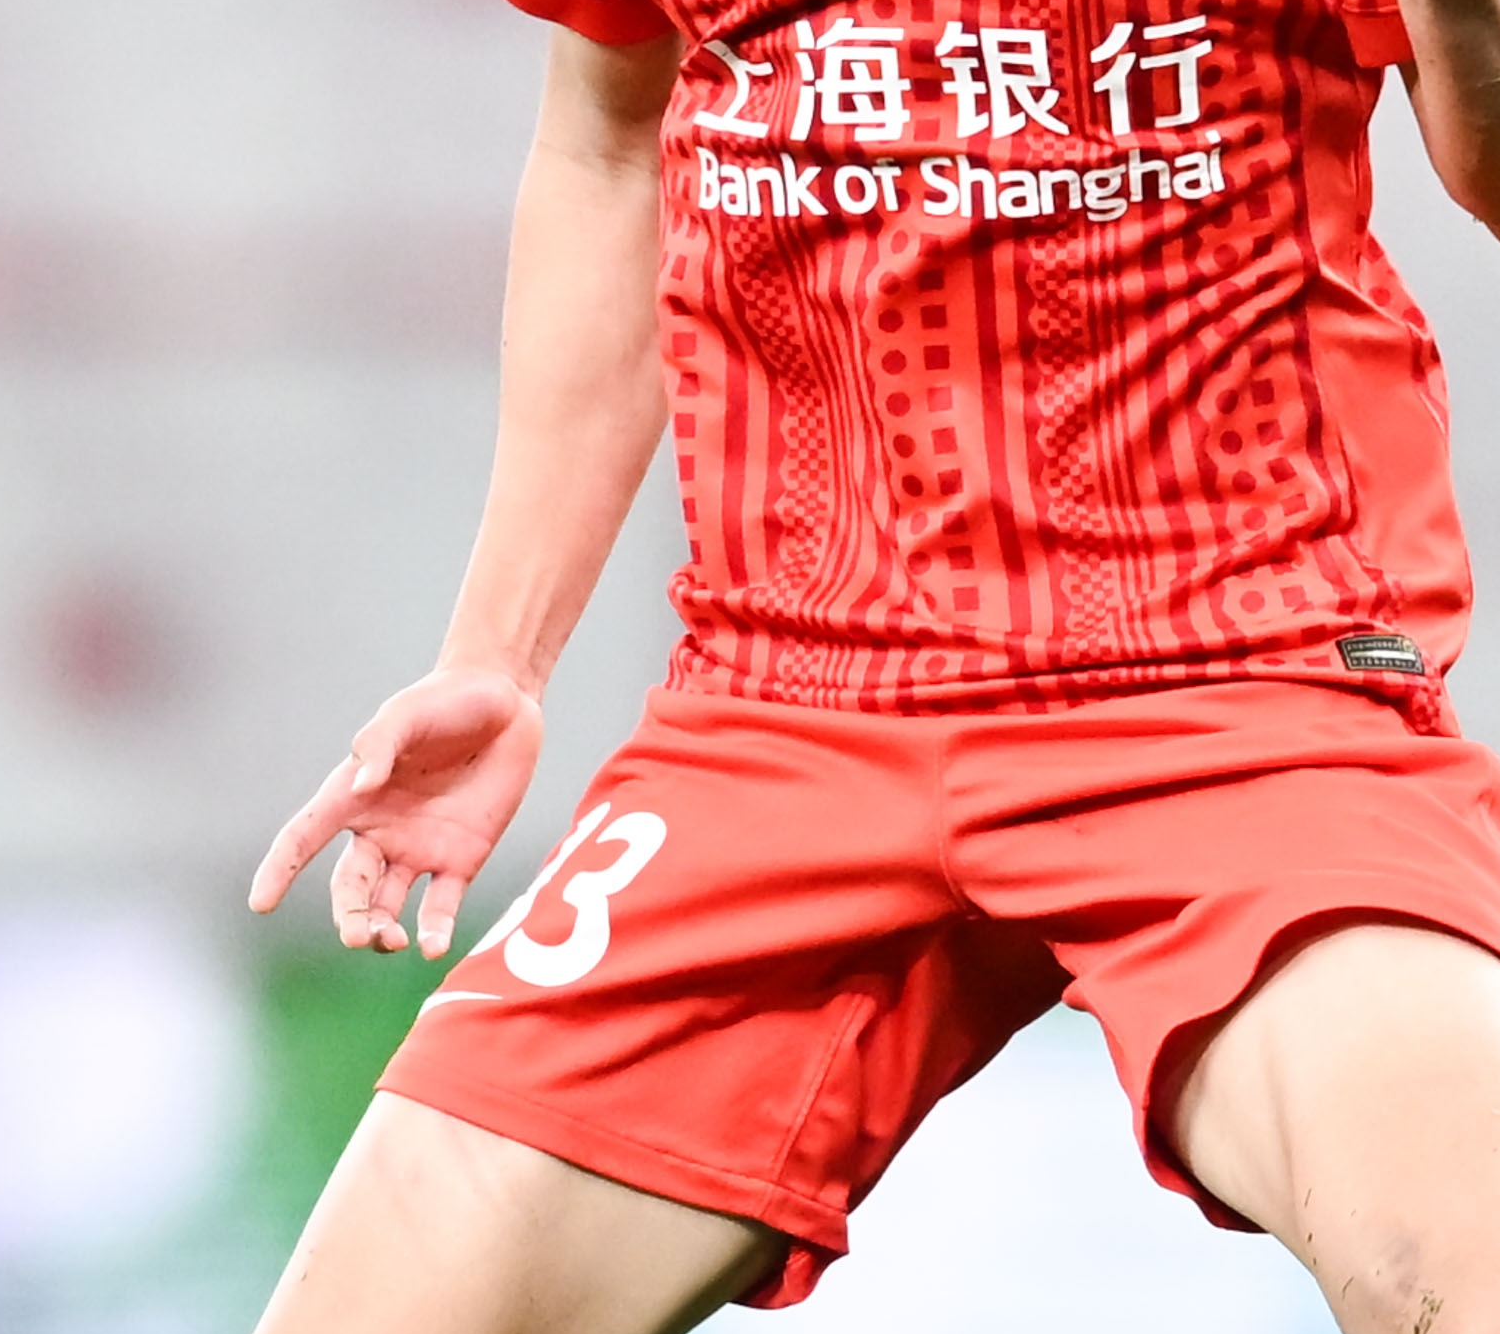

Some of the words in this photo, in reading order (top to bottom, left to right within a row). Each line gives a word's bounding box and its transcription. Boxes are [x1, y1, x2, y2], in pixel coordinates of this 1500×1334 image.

[692, 15, 1213, 142] 上海银行
[696, 146, 829, 218] Bank
[834, 160, 903, 212] of
[920, 130, 1227, 222] Shanghai
